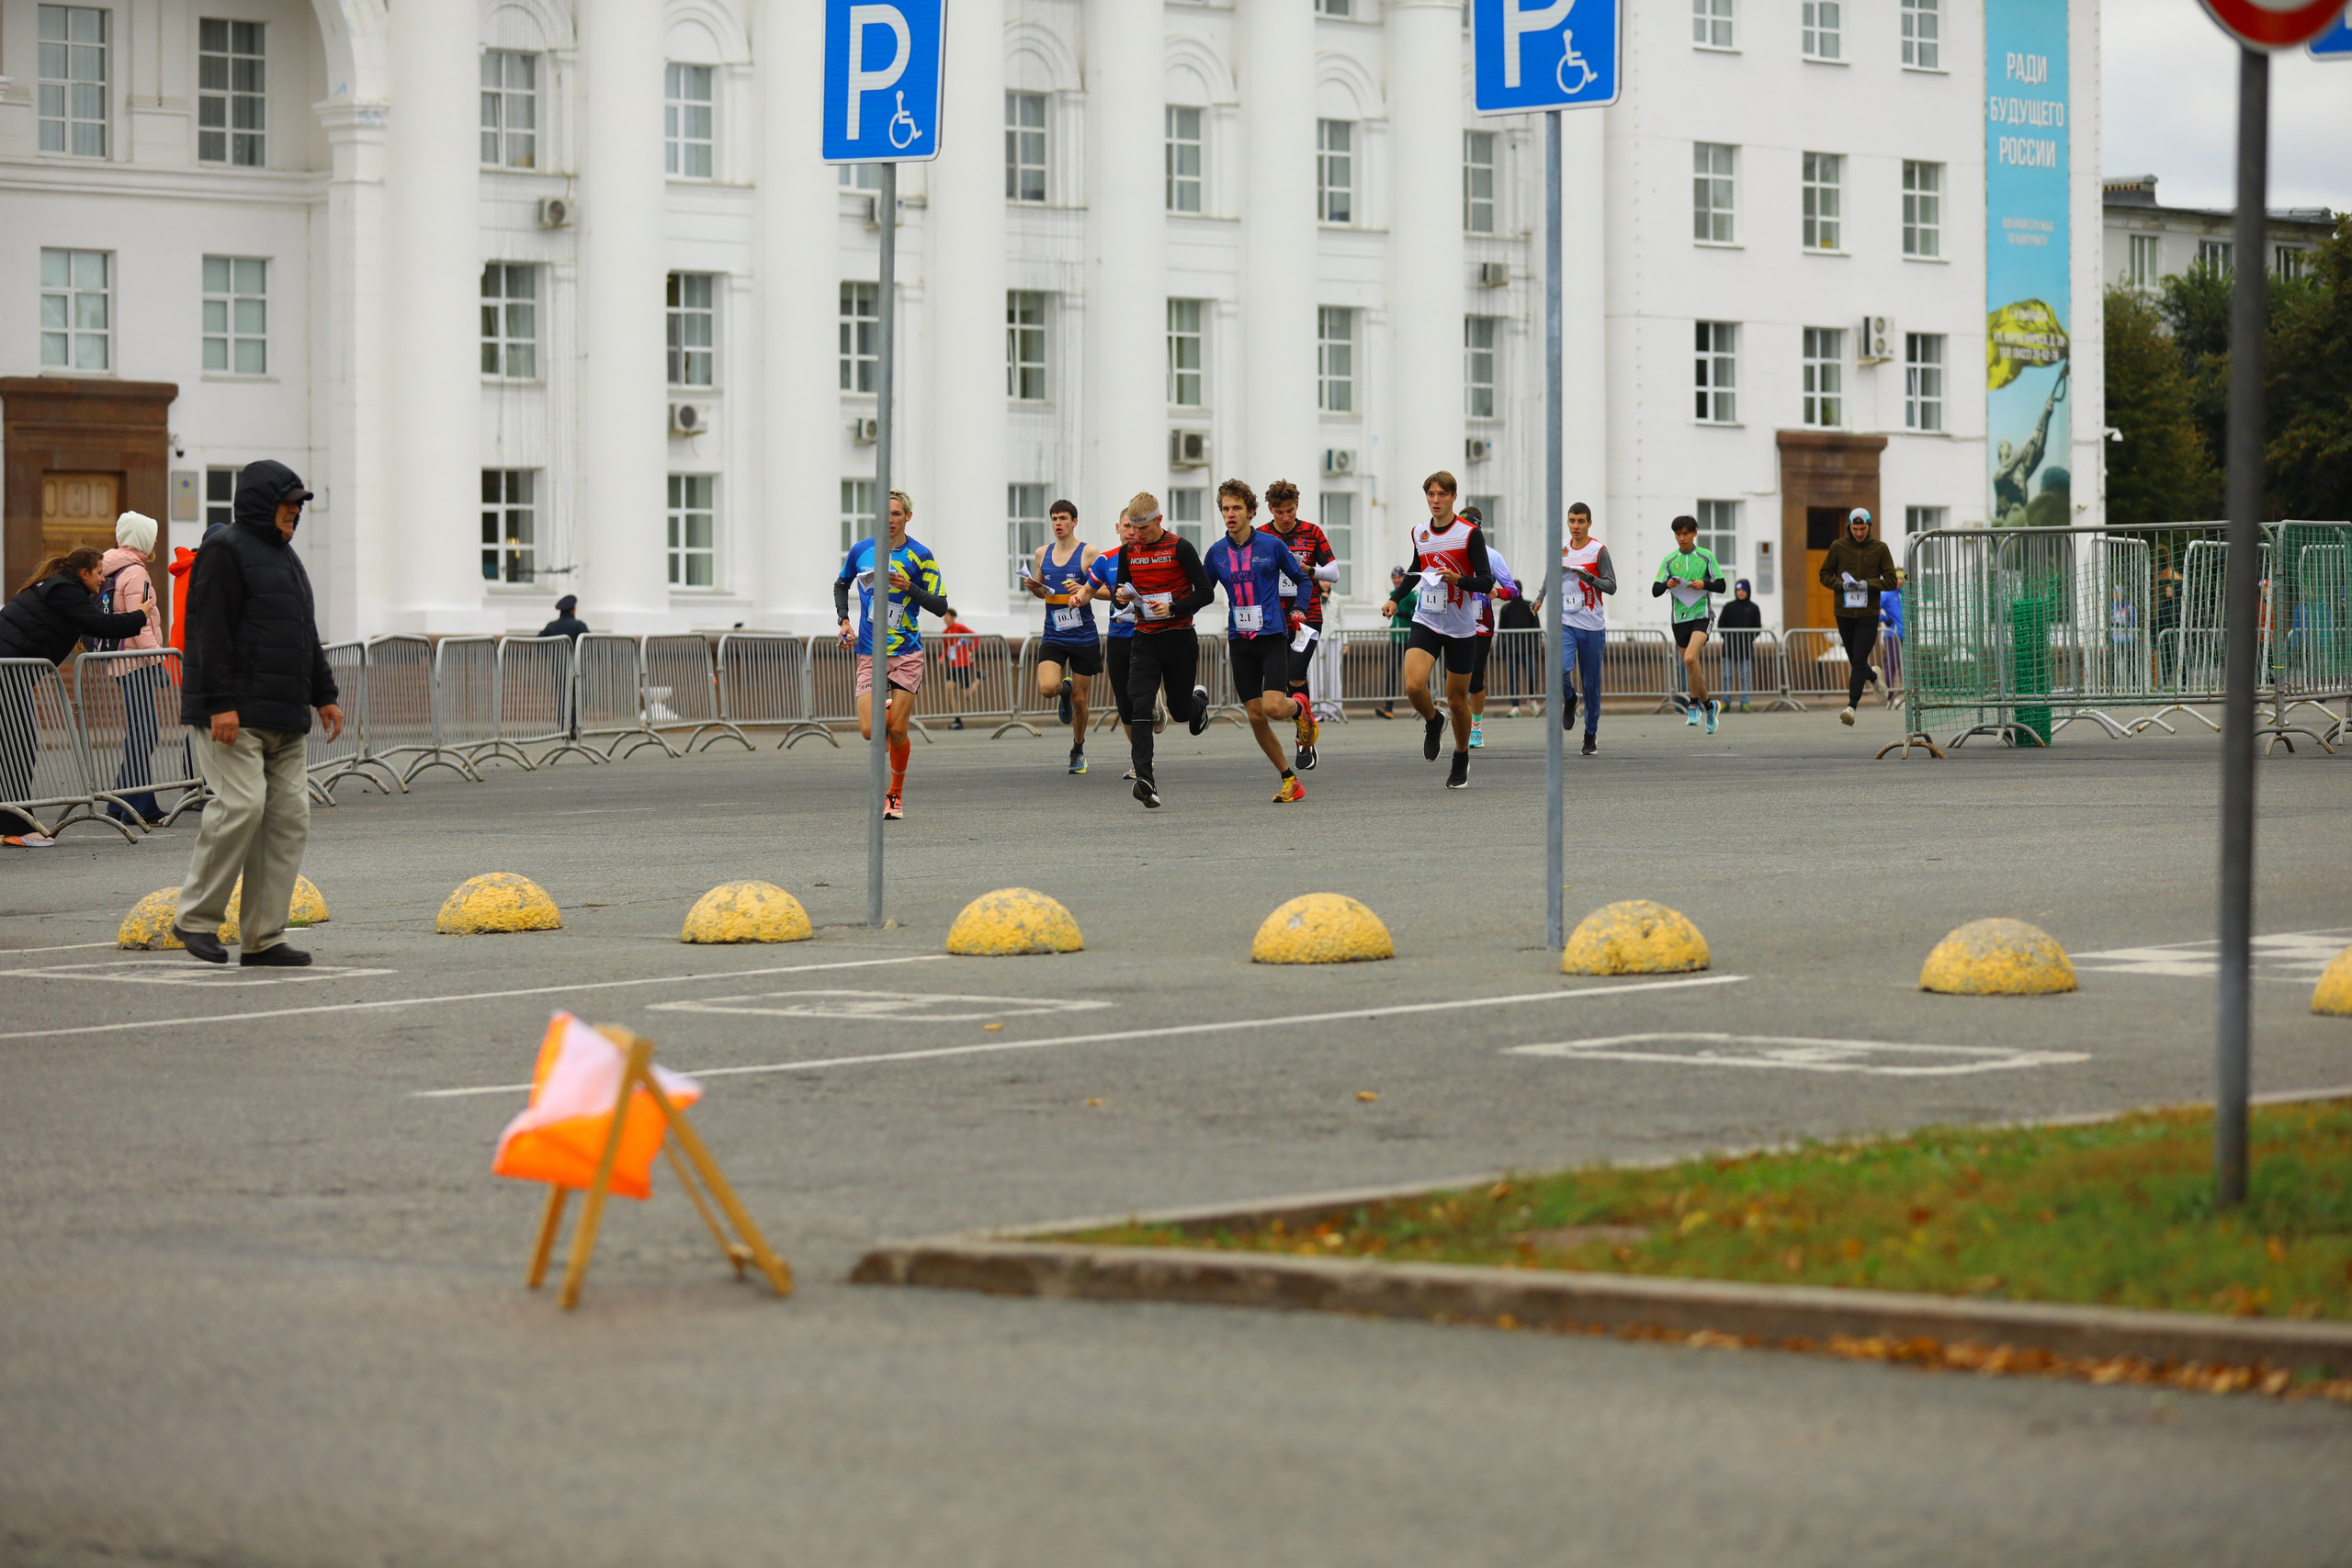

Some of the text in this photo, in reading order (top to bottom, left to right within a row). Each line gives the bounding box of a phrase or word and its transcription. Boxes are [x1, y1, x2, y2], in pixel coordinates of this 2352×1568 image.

[846, 4, 911, 141] P
[2007, 52, 2047, 85] РАДИ
[1990, 96, 2064, 127] БУДУЩЕГО
[1999, 136, 2056, 169] РОССИИ
[1130, 557, 1149, 565] NORD
[1433, 555, 1447, 568] Run
[1426, 594, 1437, 604] 1.1
[1566, 597, 1576, 605] 8.1
[1057, 613, 1073, 623] 10.1
[1239, 613, 1251, 622] 2.1
